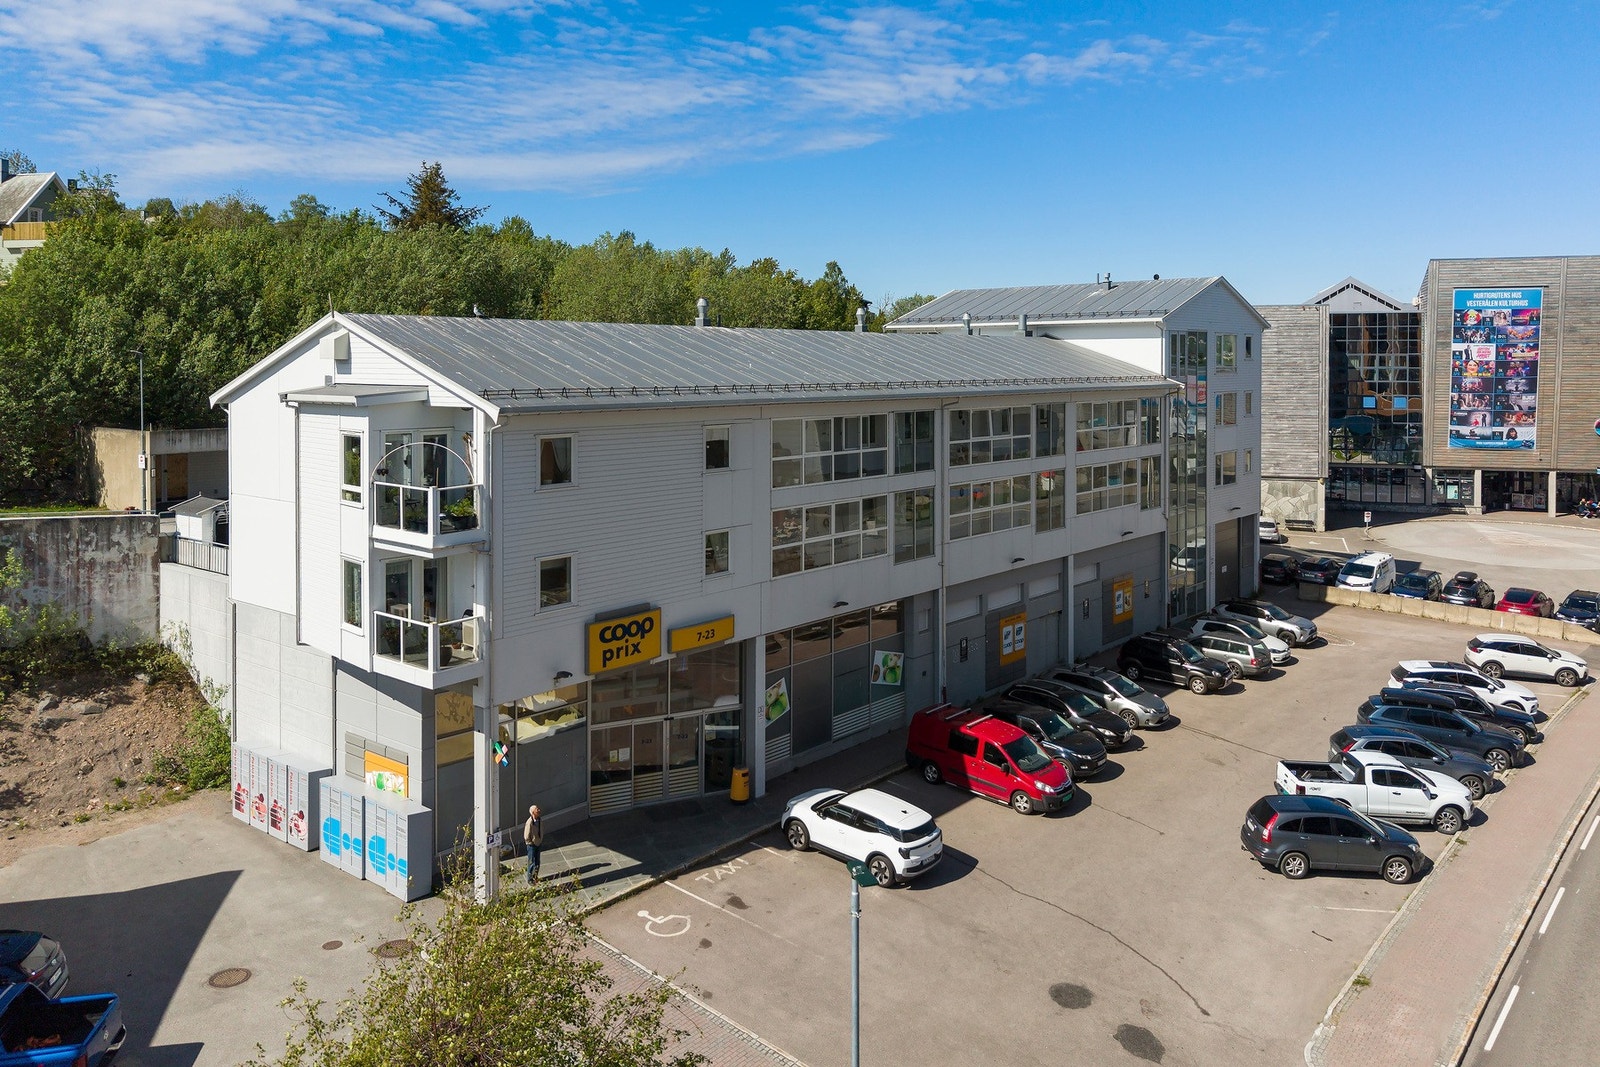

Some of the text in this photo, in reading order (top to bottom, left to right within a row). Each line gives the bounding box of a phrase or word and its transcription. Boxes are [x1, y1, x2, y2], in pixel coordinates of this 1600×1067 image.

[1466, 299, 1529, 307] VESTERÅLEN KULTURHUS
[599, 616, 654, 643] coop
[697, 628, 715, 641] 7-23
[602, 639, 641, 667] prix
[695, 857, 749, 884] TAXI
